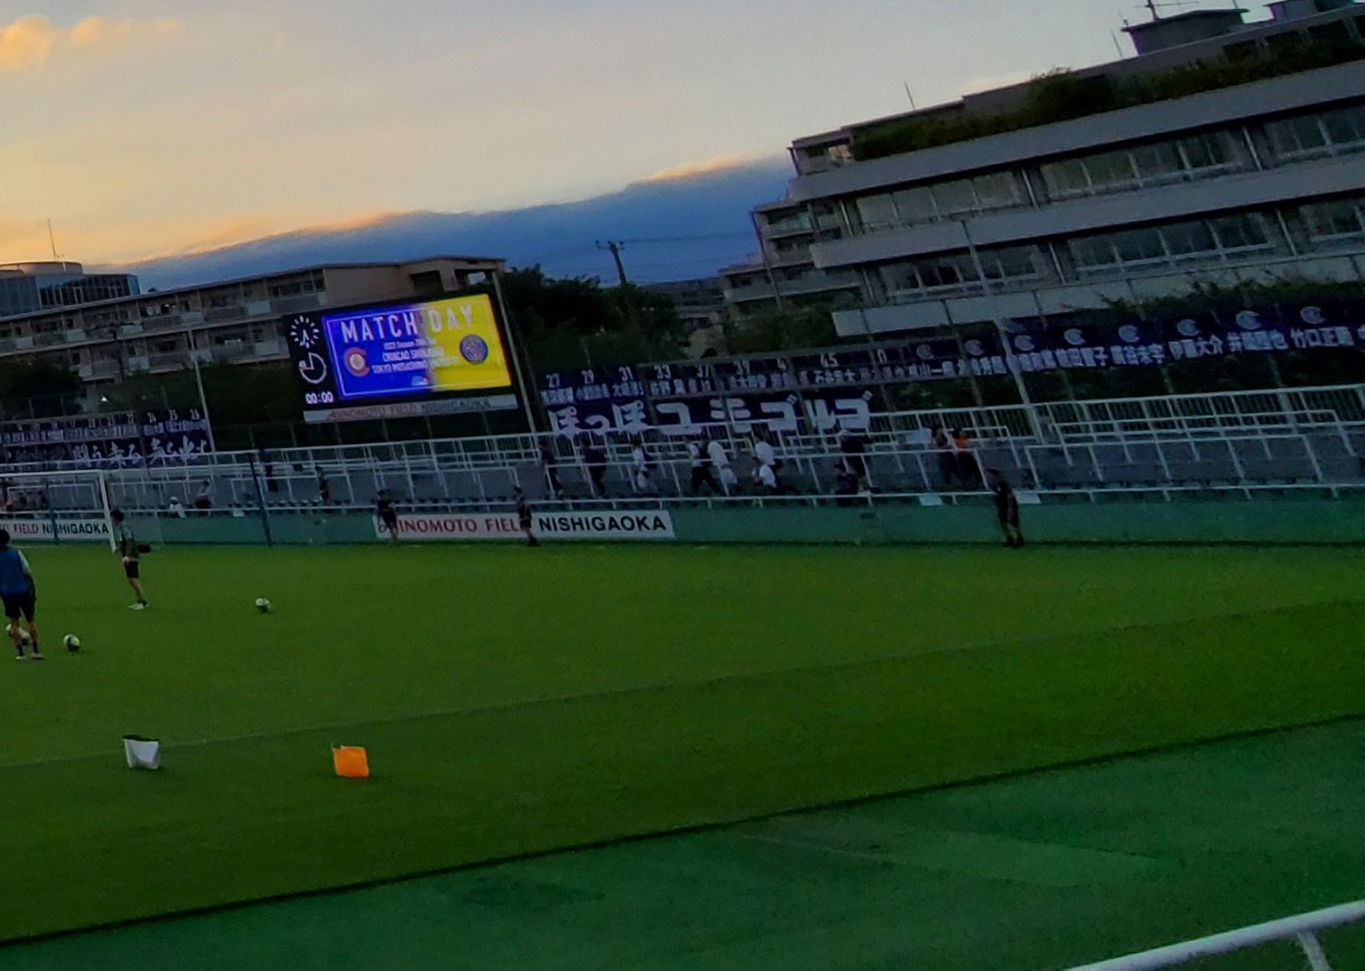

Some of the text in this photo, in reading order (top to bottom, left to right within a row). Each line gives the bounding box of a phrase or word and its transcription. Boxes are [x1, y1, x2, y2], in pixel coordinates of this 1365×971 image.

[340, 305, 472, 343] MATCH DAY
[619, 366, 634, 381] 31
[654, 365, 671, 379] 33
[305, 391, 334, 405] 00:00
[13, 523, 38, 535] FIELD
[485, 517, 530, 532] FIEL
[538, 515, 667, 533] NISHIGAOKA
